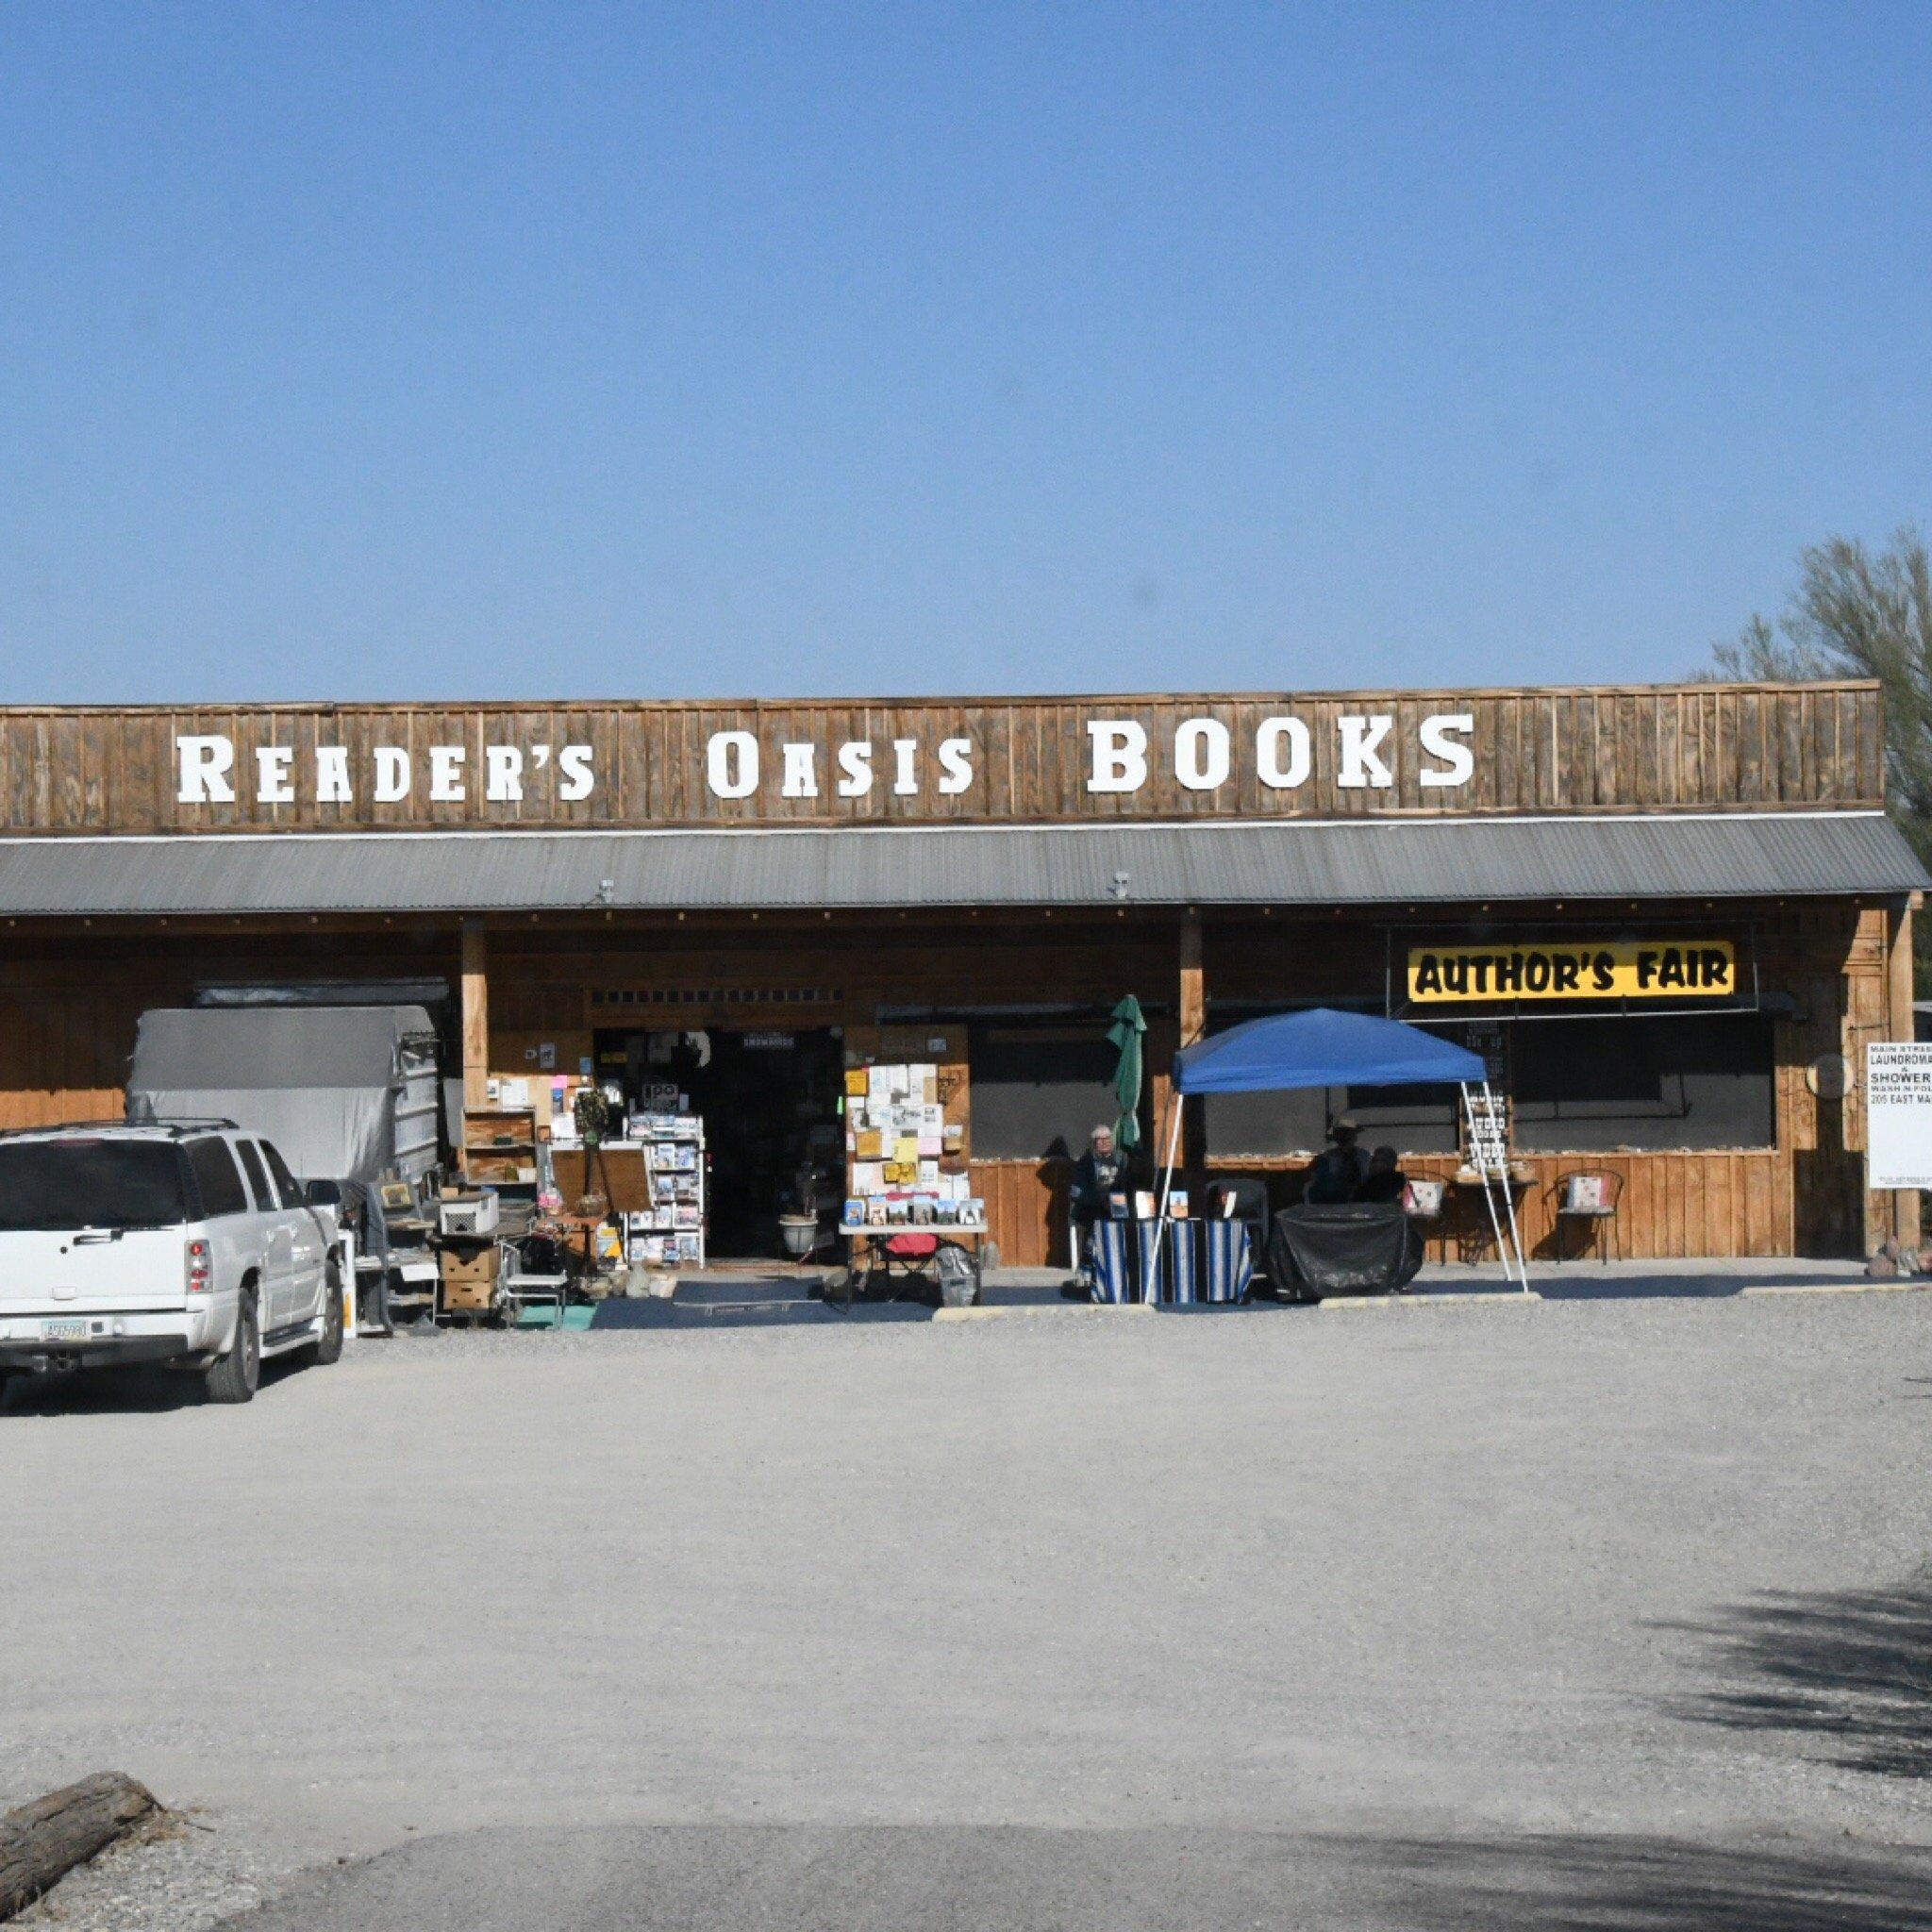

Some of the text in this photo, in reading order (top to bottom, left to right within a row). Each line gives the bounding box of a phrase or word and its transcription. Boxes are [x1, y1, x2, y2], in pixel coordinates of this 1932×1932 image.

[176, 713, 1474, 802] READER'S OASIS BOOKS
[1414, 947, 1729, 995] AUTHOR'S FAIR
[1871, 1073, 1931, 1083] SHOWER
[1890, 1094, 1913, 1105] EAST
